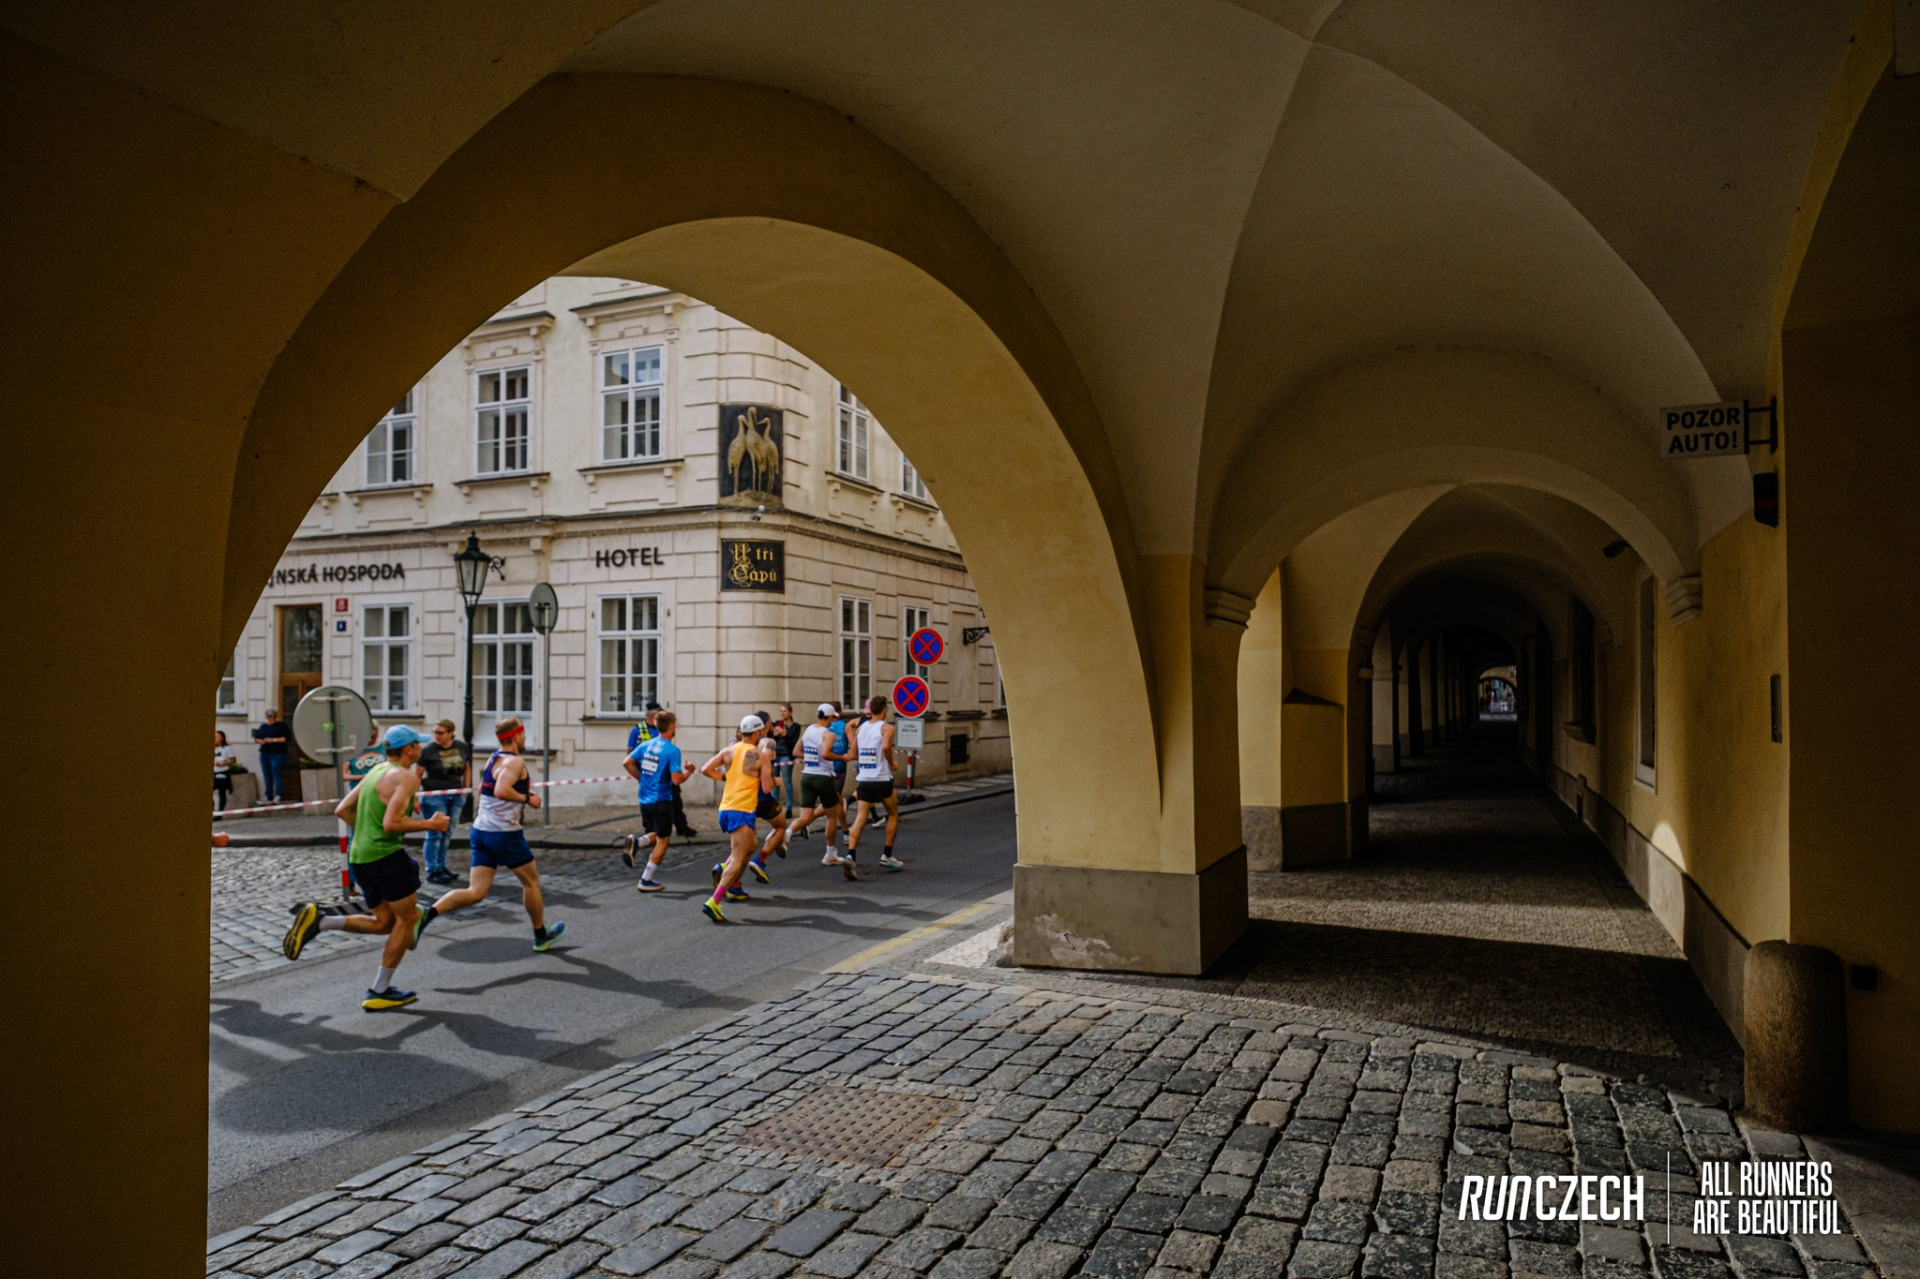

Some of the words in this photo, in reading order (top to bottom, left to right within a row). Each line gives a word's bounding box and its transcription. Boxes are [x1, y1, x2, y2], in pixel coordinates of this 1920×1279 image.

[1667, 407, 1741, 431] POZOR
[1668, 430, 1738, 454] AUTO!
[596, 547, 664, 568] HOTEL
[322, 562, 405, 582] HOSPODA
